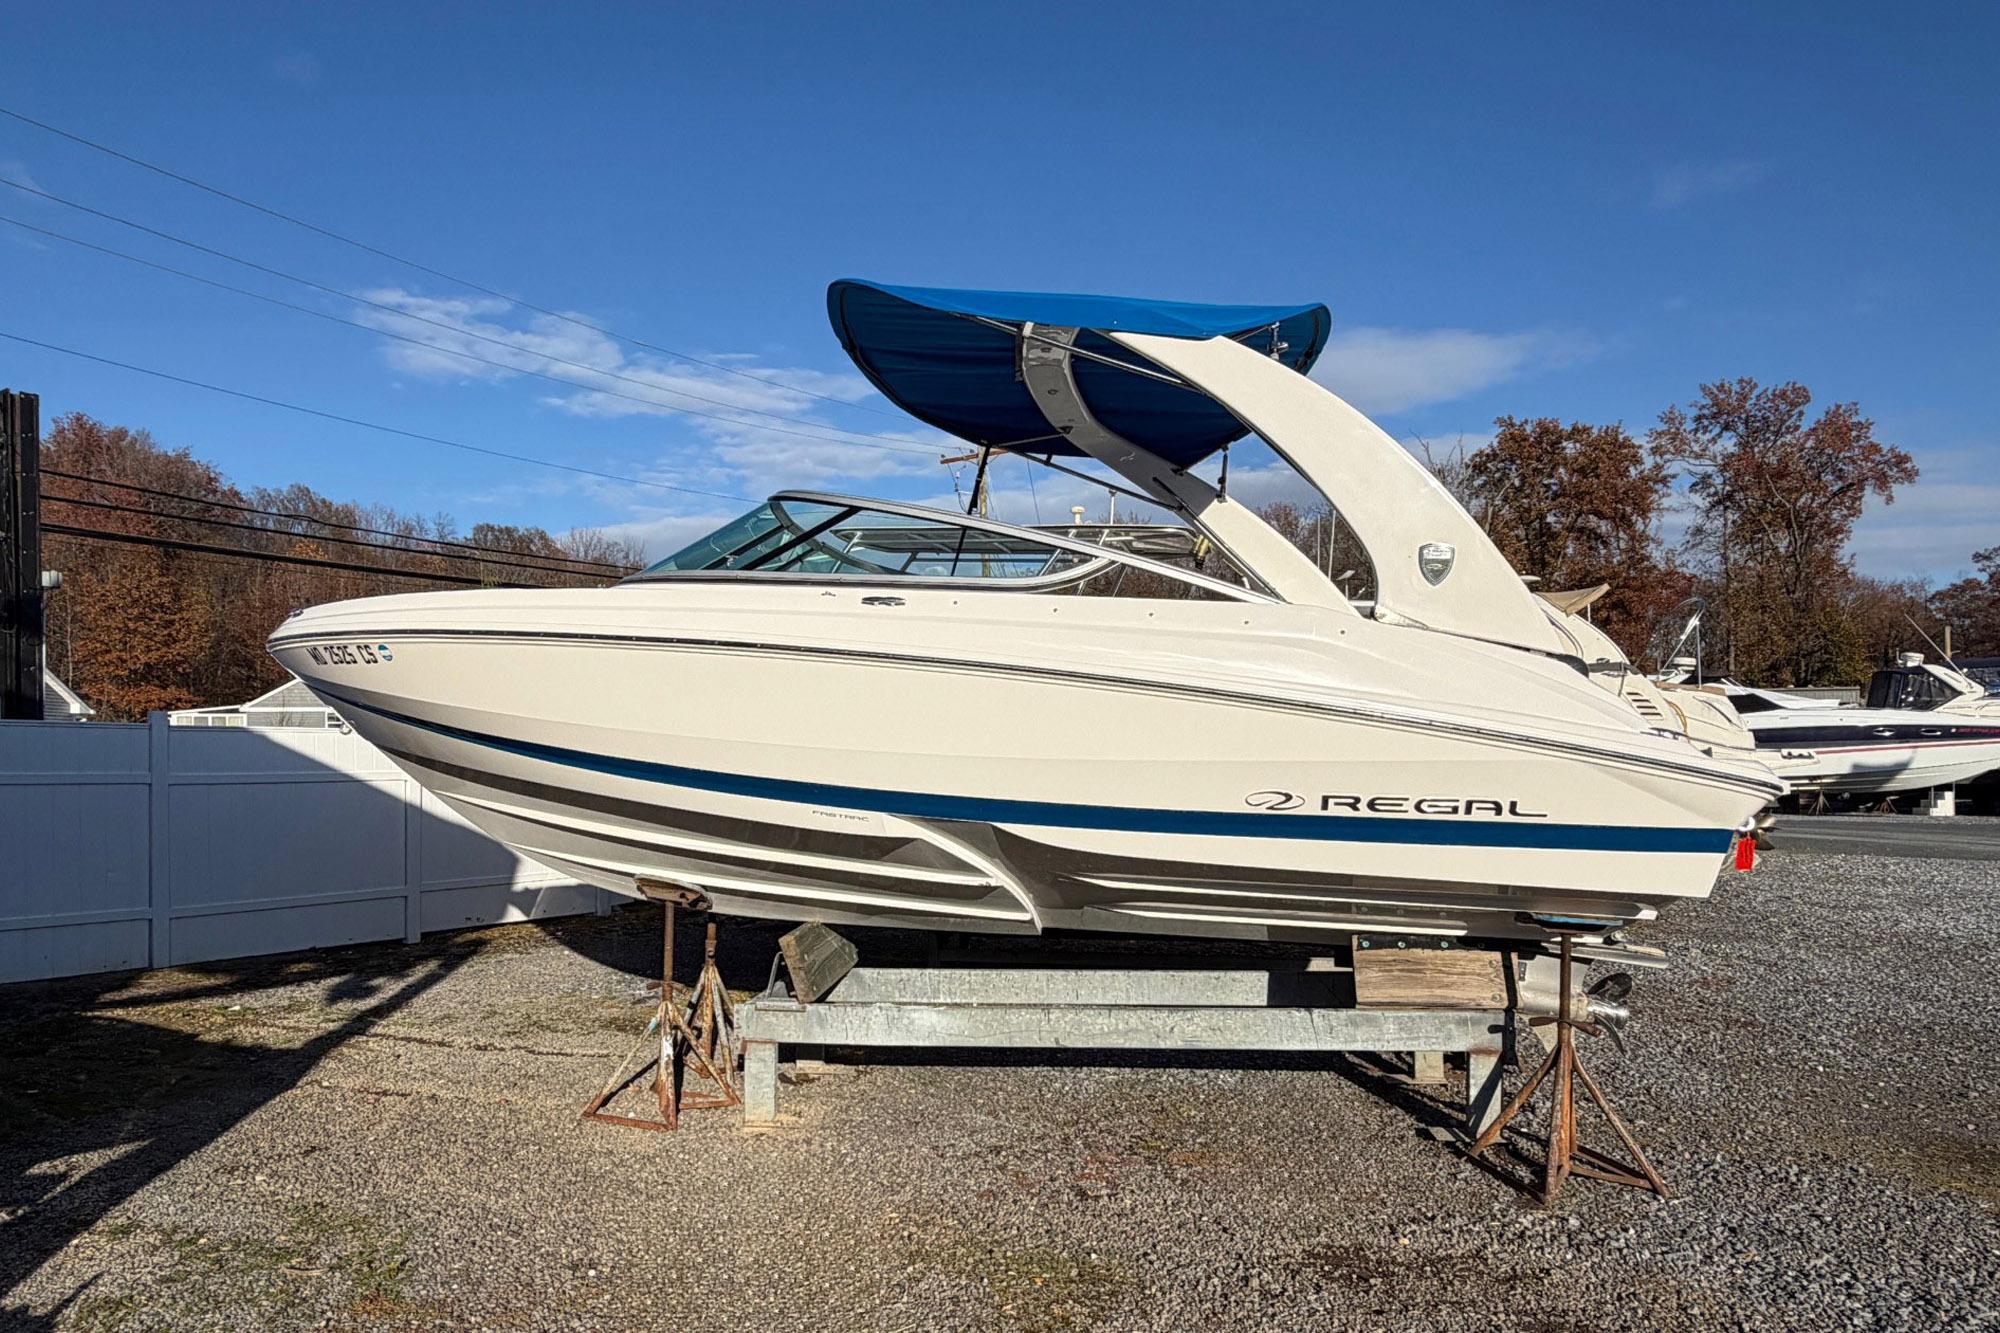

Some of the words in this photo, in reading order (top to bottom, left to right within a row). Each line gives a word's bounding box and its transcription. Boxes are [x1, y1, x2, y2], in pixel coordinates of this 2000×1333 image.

[323, 645, 358, 665] 2525
[356, 644, 379, 664] CS
[1320, 794, 1548, 818] REGAL
